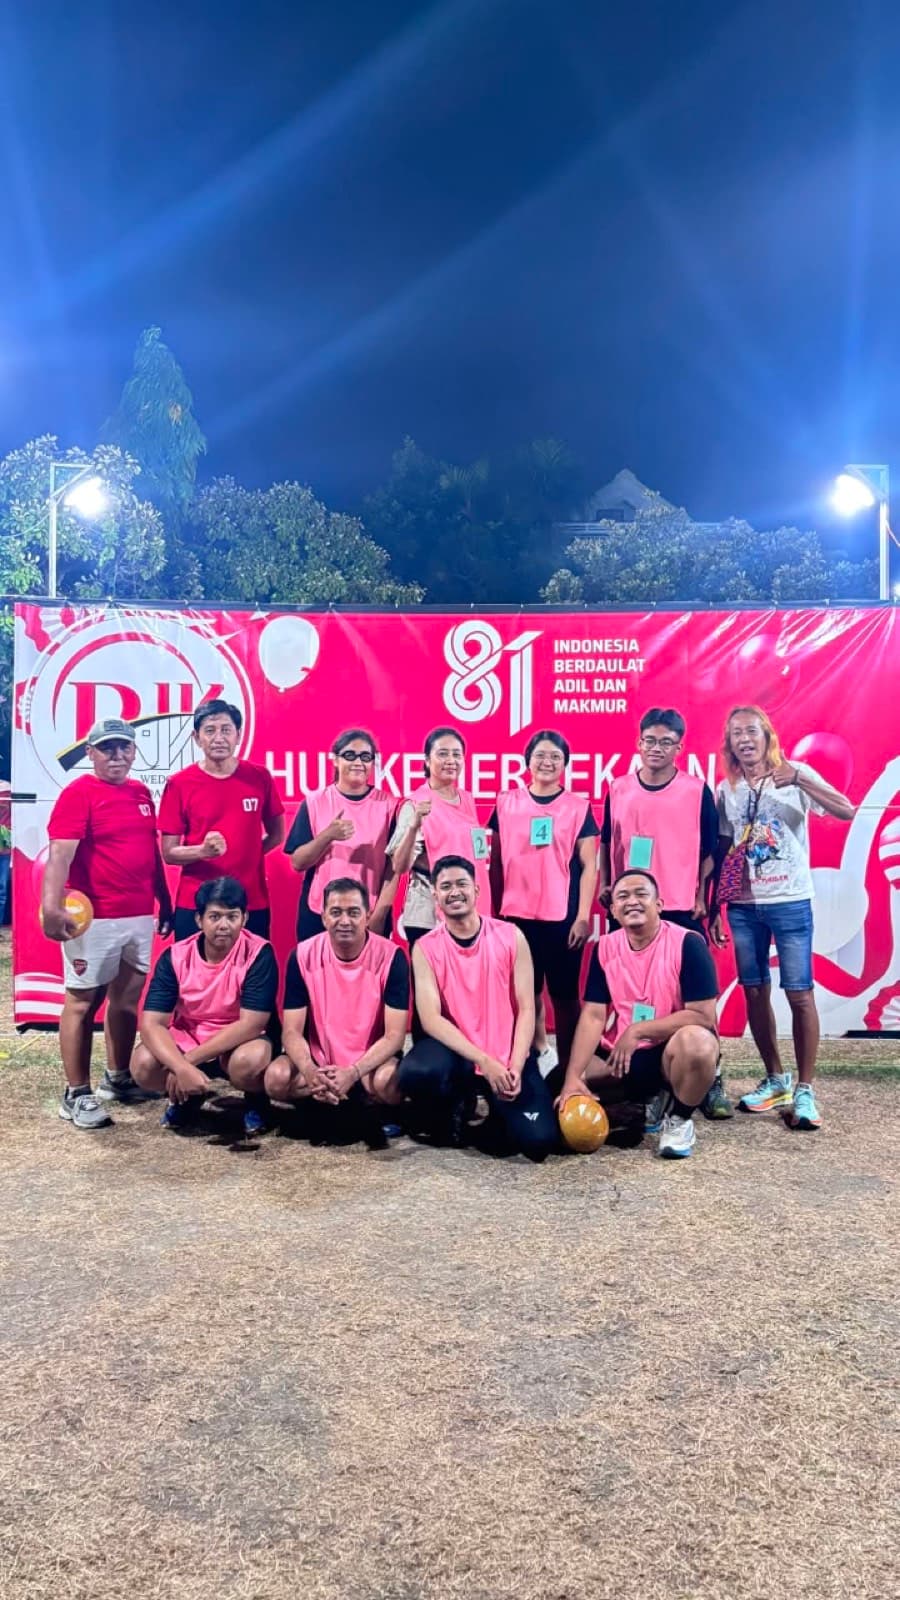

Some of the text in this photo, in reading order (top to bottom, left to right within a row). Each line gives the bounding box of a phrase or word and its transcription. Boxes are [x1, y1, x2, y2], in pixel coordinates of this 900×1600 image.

[553, 639, 640, 653] INDONESIA
[553, 659, 646, 673] BERDAULAT
[443, 619, 544, 737] 81
[553, 679, 627, 693] ADIL DAN
[553, 699, 628, 713] MAKMUR
[265, 751, 337, 797] HU
[242, 798, 259, 812] 07
[535, 824, 548, 841] 4
[477, 836, 486, 854] 2
